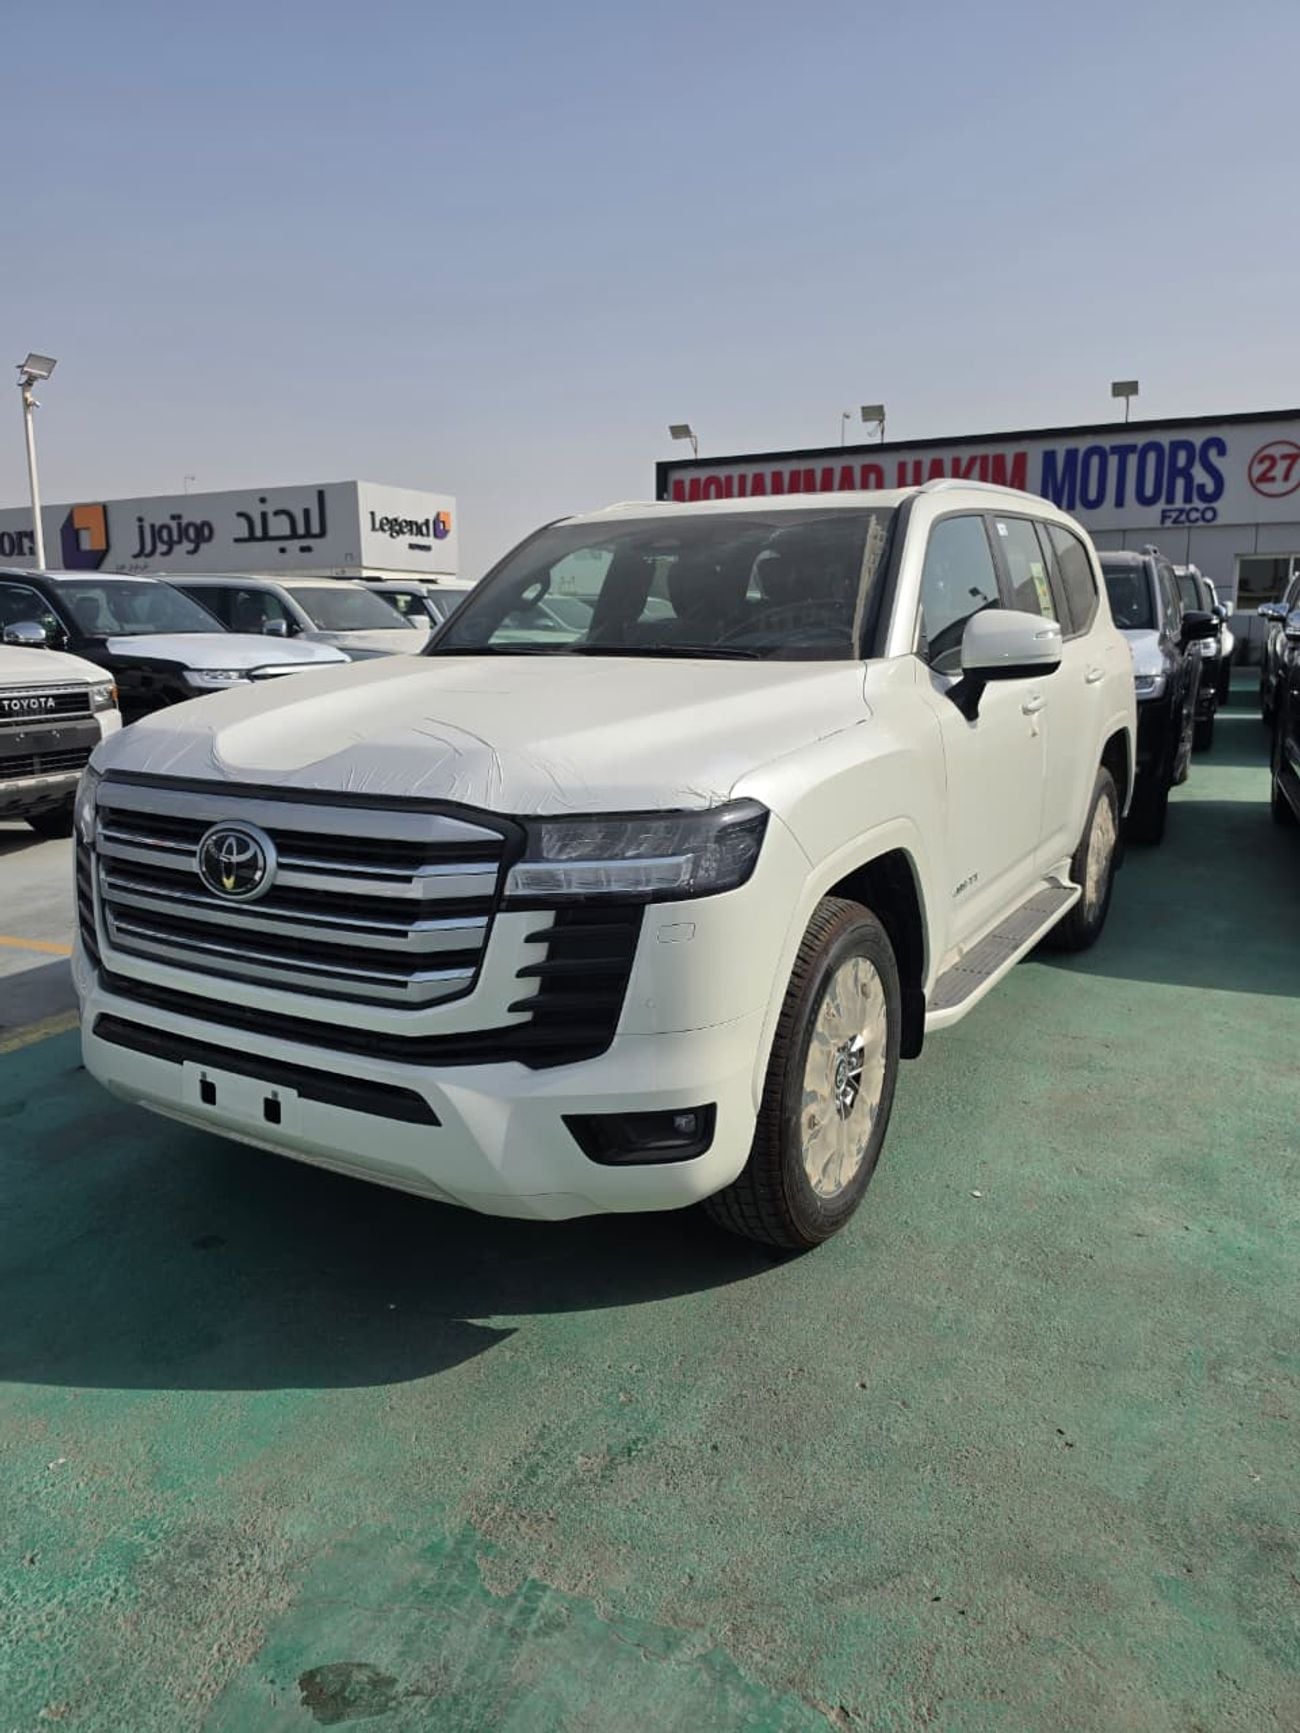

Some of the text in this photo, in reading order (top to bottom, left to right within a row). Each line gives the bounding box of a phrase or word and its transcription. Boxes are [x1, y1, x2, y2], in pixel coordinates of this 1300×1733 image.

[1041, 437, 1227, 511] MOTORS
[1255, 453, 1300, 484] 27
[131, 489, 327, 559] ليجند موتورز
[369, 510, 431, 539] Legend
[1160, 506, 1218, 525] FZCO
[2, 697, 56, 711] TOYOTA
